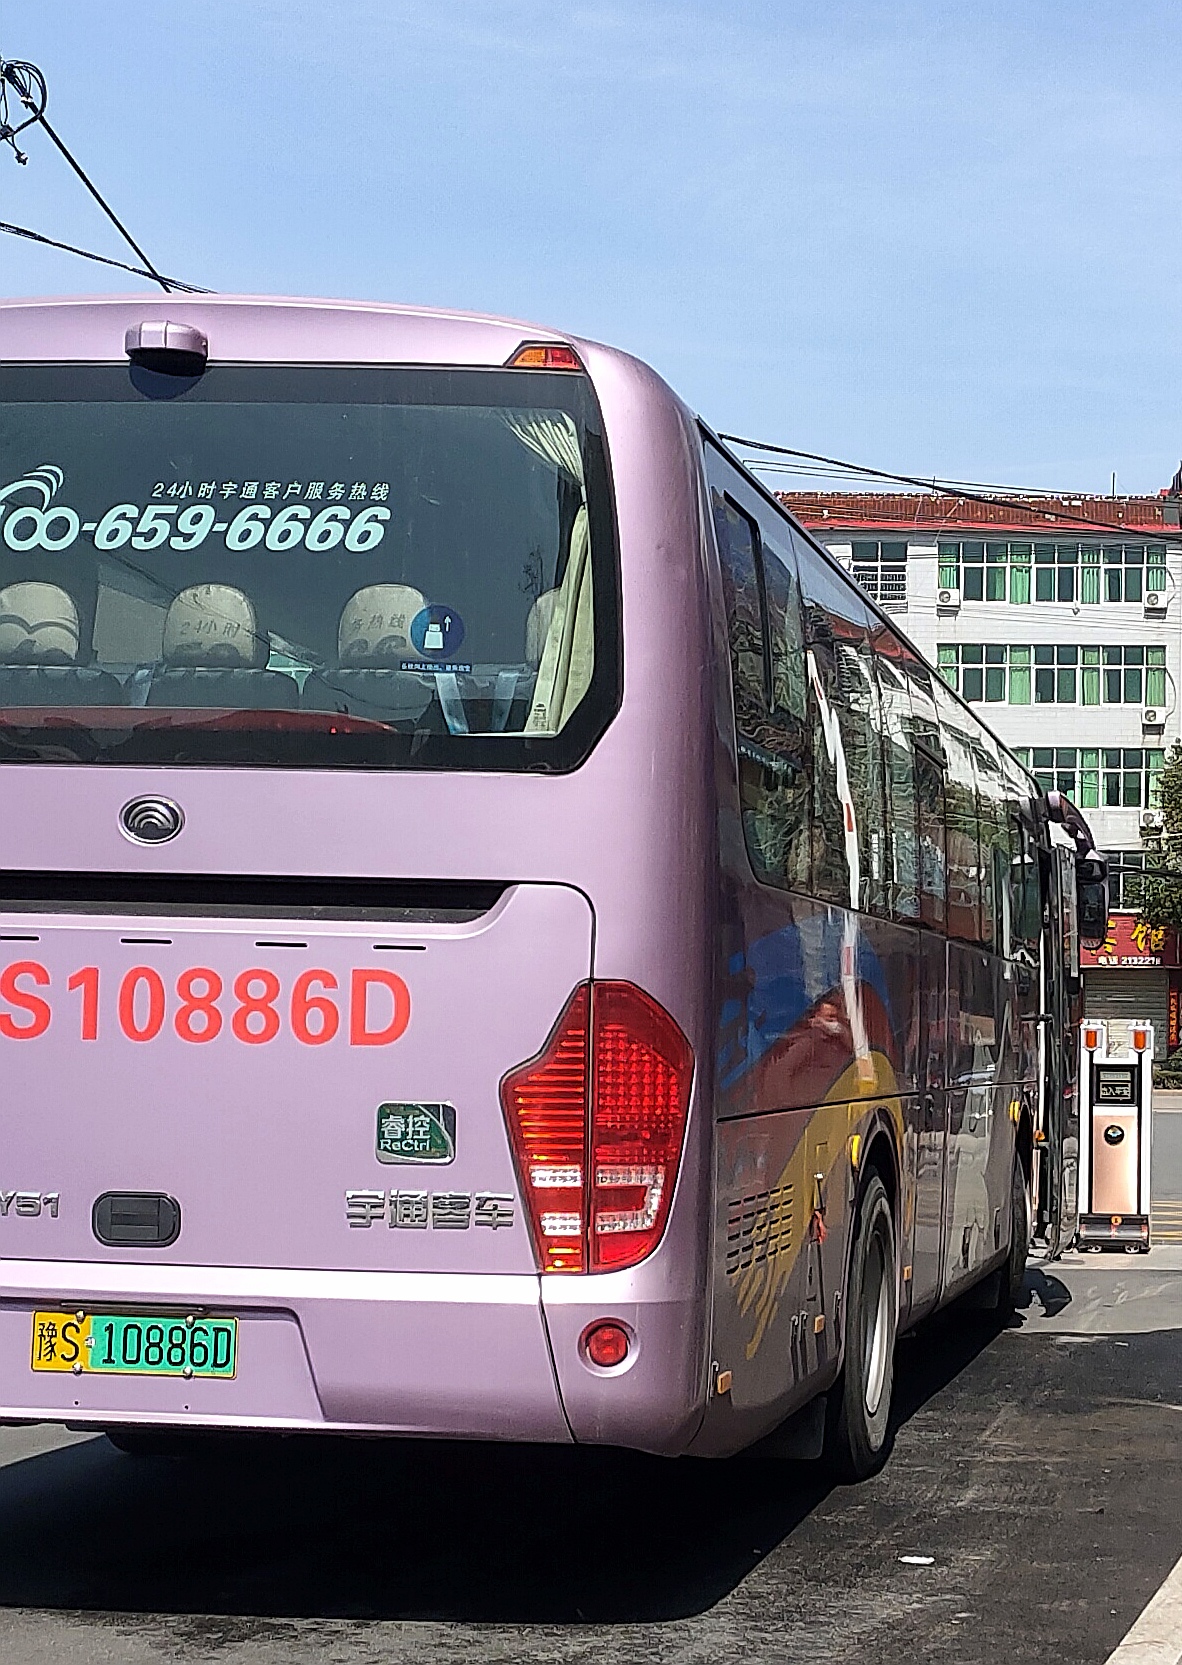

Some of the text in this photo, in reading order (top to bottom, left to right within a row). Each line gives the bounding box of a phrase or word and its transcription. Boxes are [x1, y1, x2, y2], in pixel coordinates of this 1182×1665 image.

[152, 480, 390, 501] 24小时宇通客户服务热线
[0, 504, 391, 552] 00-659-6666
[0, 960, 412, 1047] S10886D
[381, 1115, 431, 1139] 睿控
[380, 1139, 430, 1151] ReCtrl
[345, 1189, 515, 1231] 宇通客车
